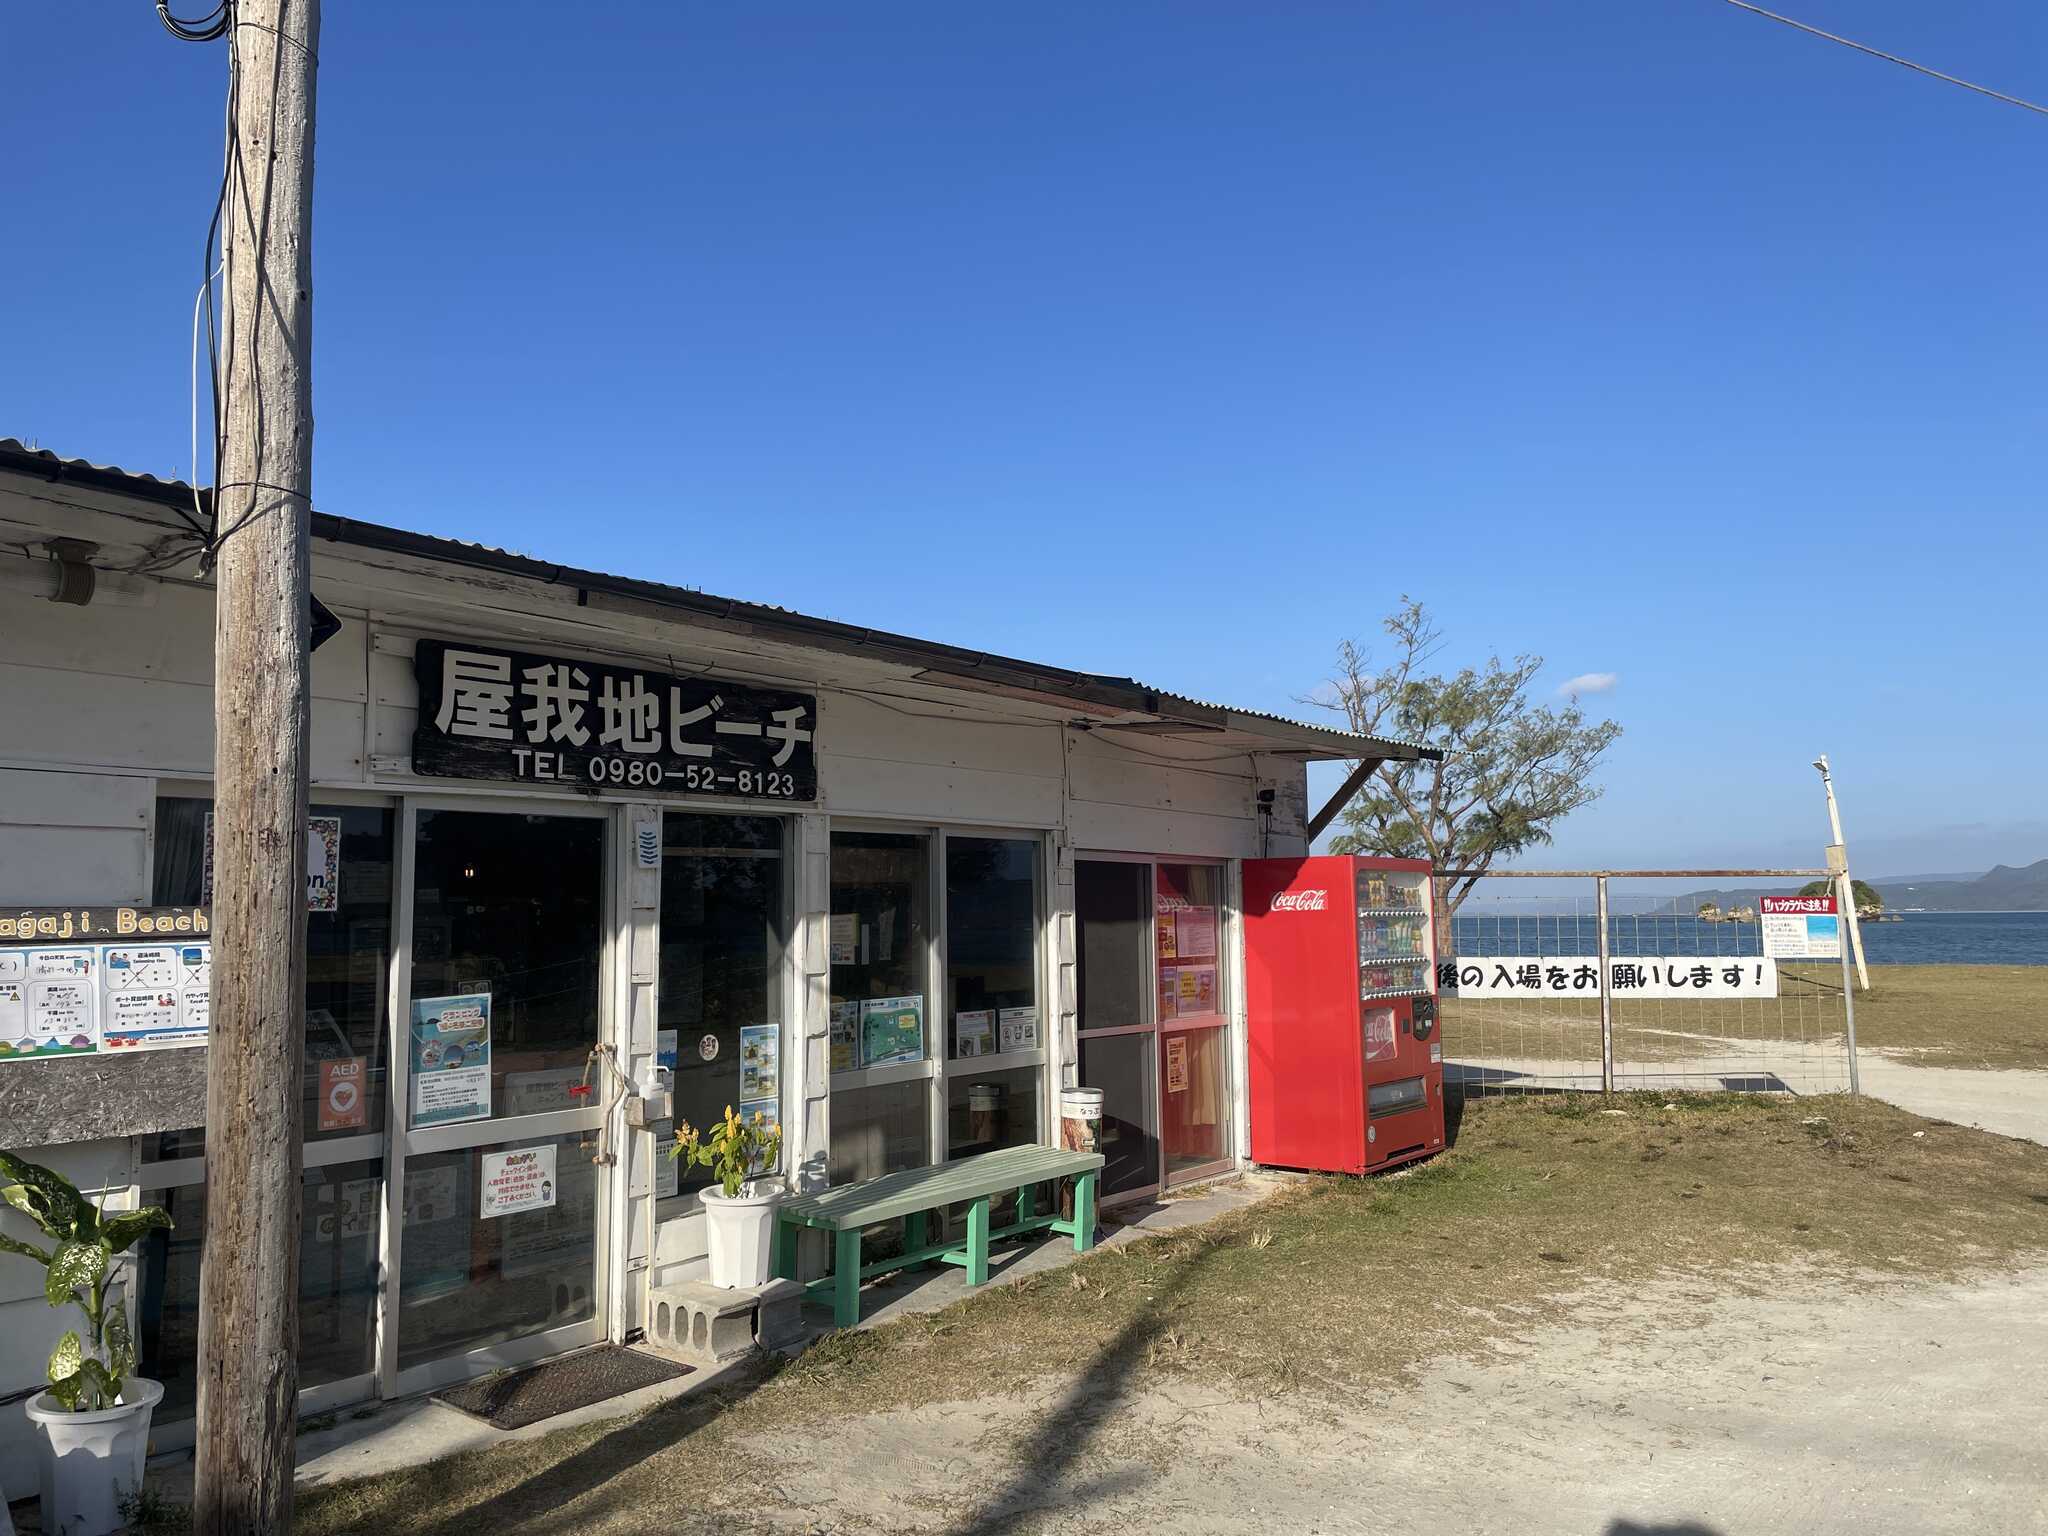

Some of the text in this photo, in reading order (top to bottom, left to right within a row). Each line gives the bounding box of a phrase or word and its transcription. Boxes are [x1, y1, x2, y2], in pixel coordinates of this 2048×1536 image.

[434, 649, 811, 768] 屋我地ビーチ
[511, 749, 795, 796] TEL 0980-52-8123
[1270, 889, 1328, 912] Coca-Cola
[116, 908, 209, 935] Beach
[329, 1063, 360, 1077] AED
